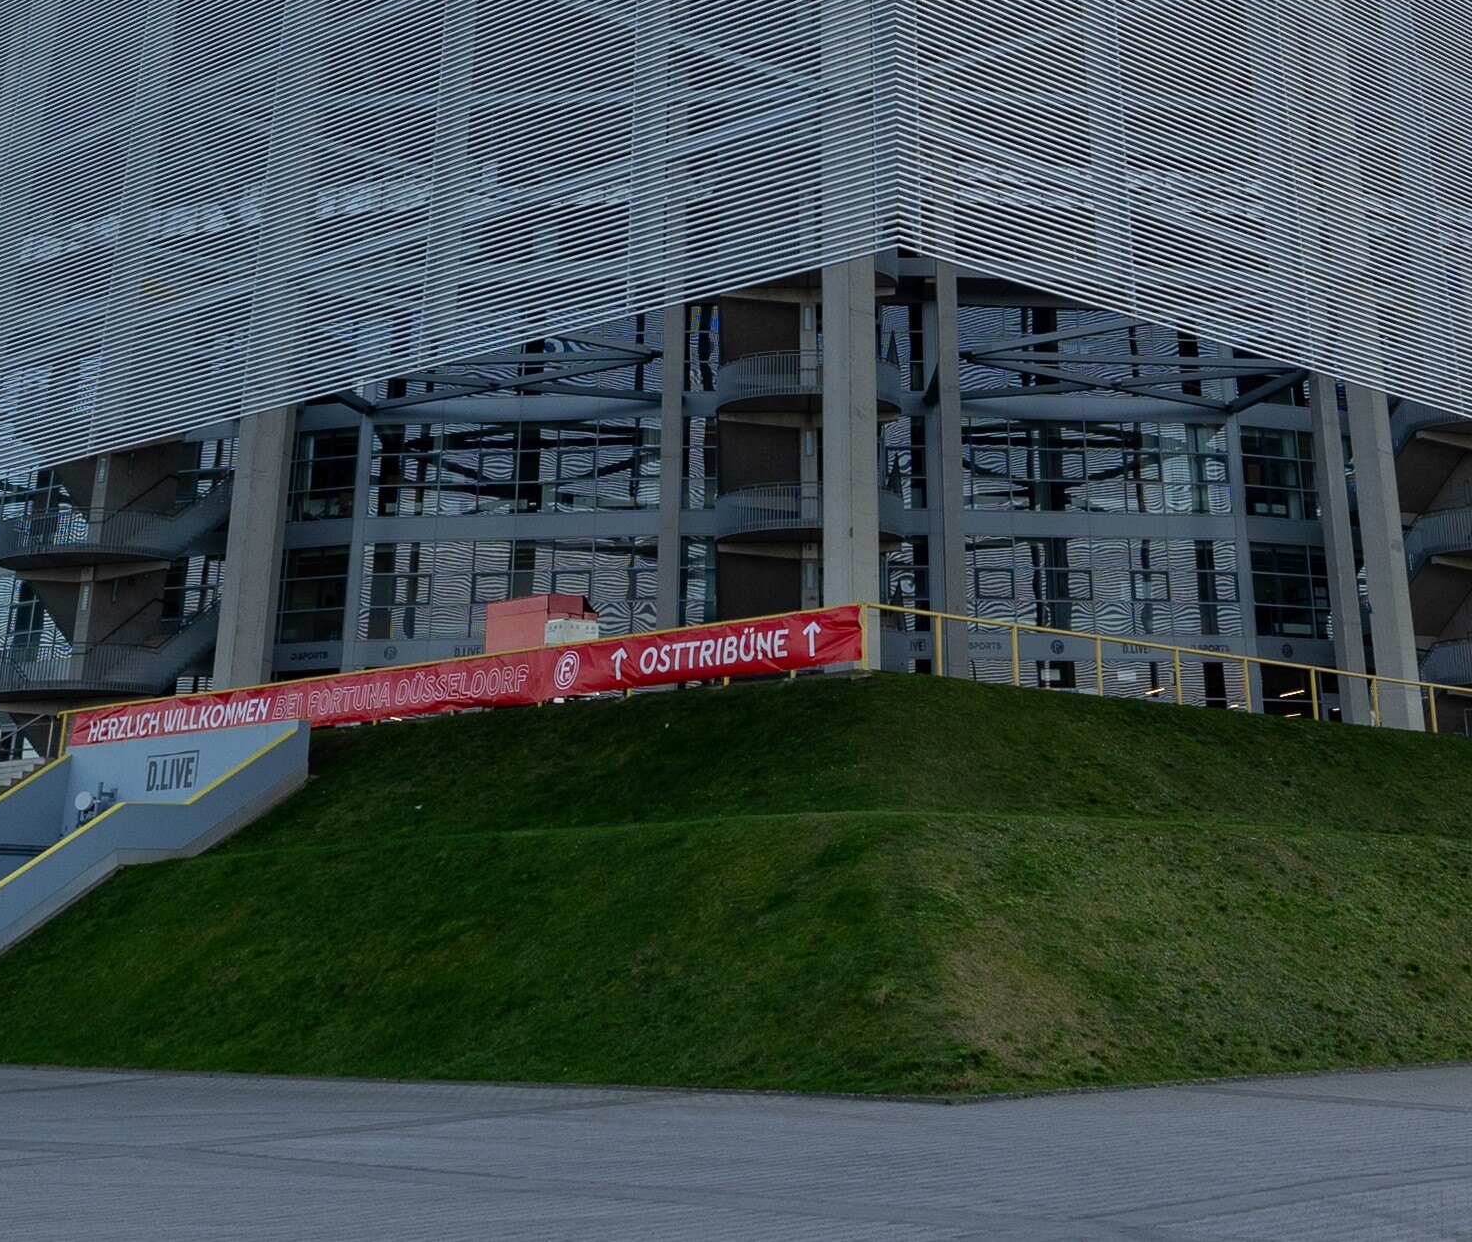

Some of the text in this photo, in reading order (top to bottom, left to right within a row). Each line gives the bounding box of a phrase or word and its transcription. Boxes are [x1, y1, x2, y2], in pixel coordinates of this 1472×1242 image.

[639, 627, 790, 675] OSTTRIBÜNE
[87, 664, 531, 743] HERZLICH WILLKOMMEN BEI FORTUNA DÜSSELDORF
[146, 756, 195, 792] D.LIVE
